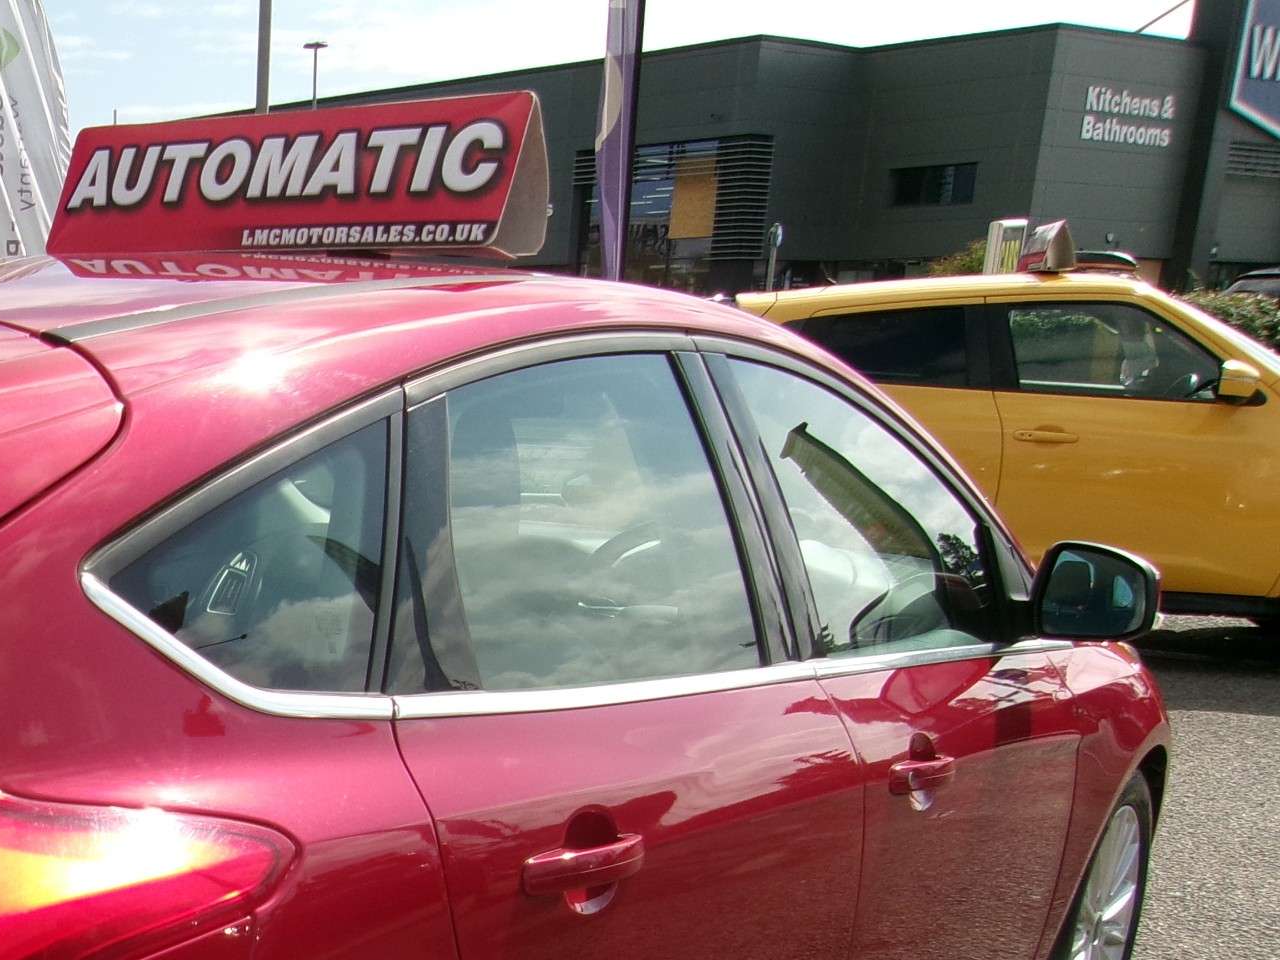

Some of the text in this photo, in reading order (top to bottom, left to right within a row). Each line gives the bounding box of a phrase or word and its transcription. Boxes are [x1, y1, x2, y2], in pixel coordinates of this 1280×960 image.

[1086, 86, 1160, 117] Kitchens
[1081, 115, 1170, 147] Bathrooms
[67, 121, 504, 209] AUTOMATIC
[241, 223, 487, 246] LMCMOTORSALES.CO.UK
